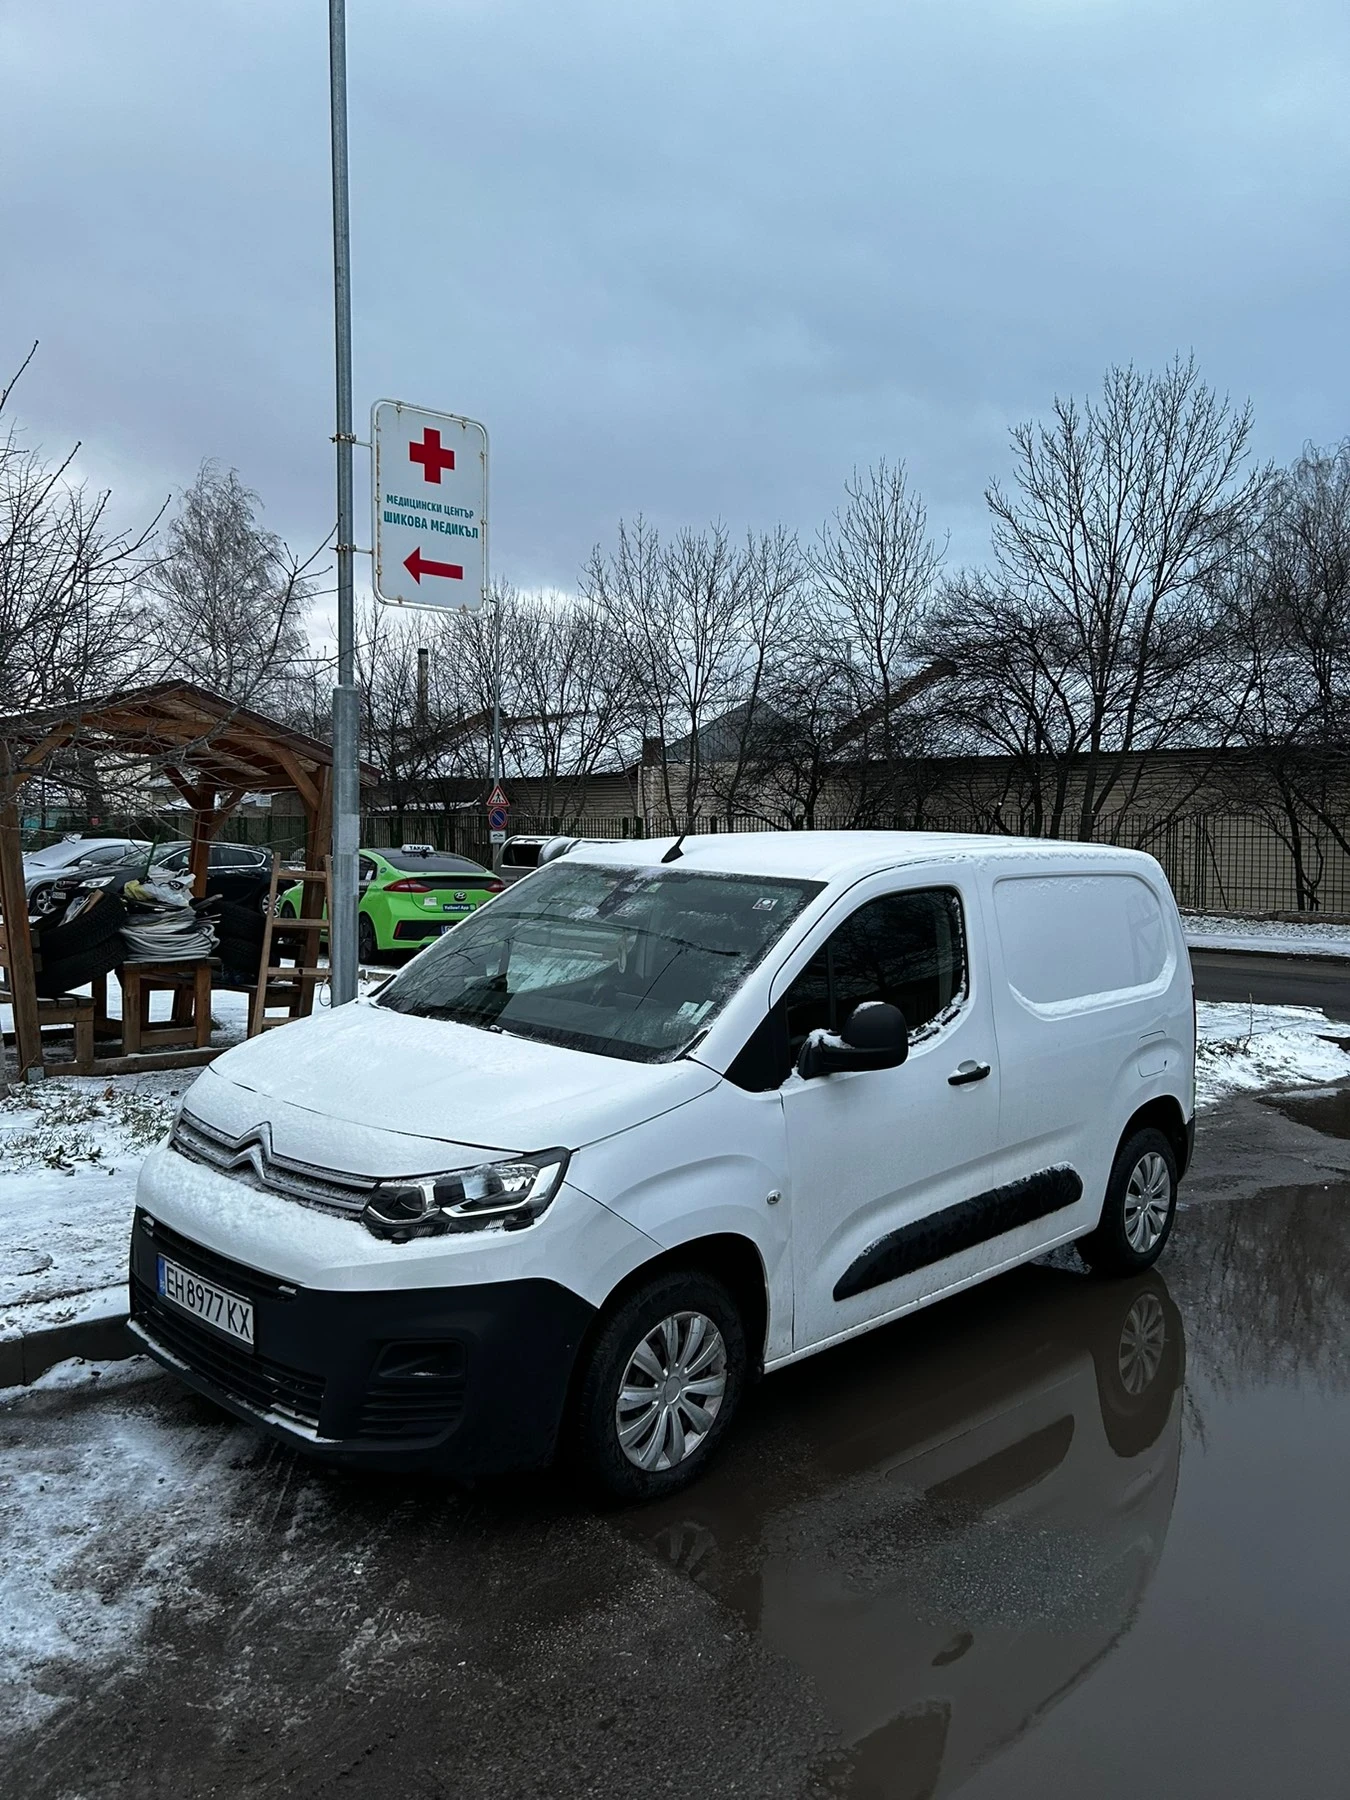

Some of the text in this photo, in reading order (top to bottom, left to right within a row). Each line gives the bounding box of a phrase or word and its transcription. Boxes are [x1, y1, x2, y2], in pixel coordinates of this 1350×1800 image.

[386, 494, 474, 519] МЕДИЦИНСКИ ЦЕНТЪР
[384, 510, 479, 539] ШИКОВА МЕДИКЪЛ
